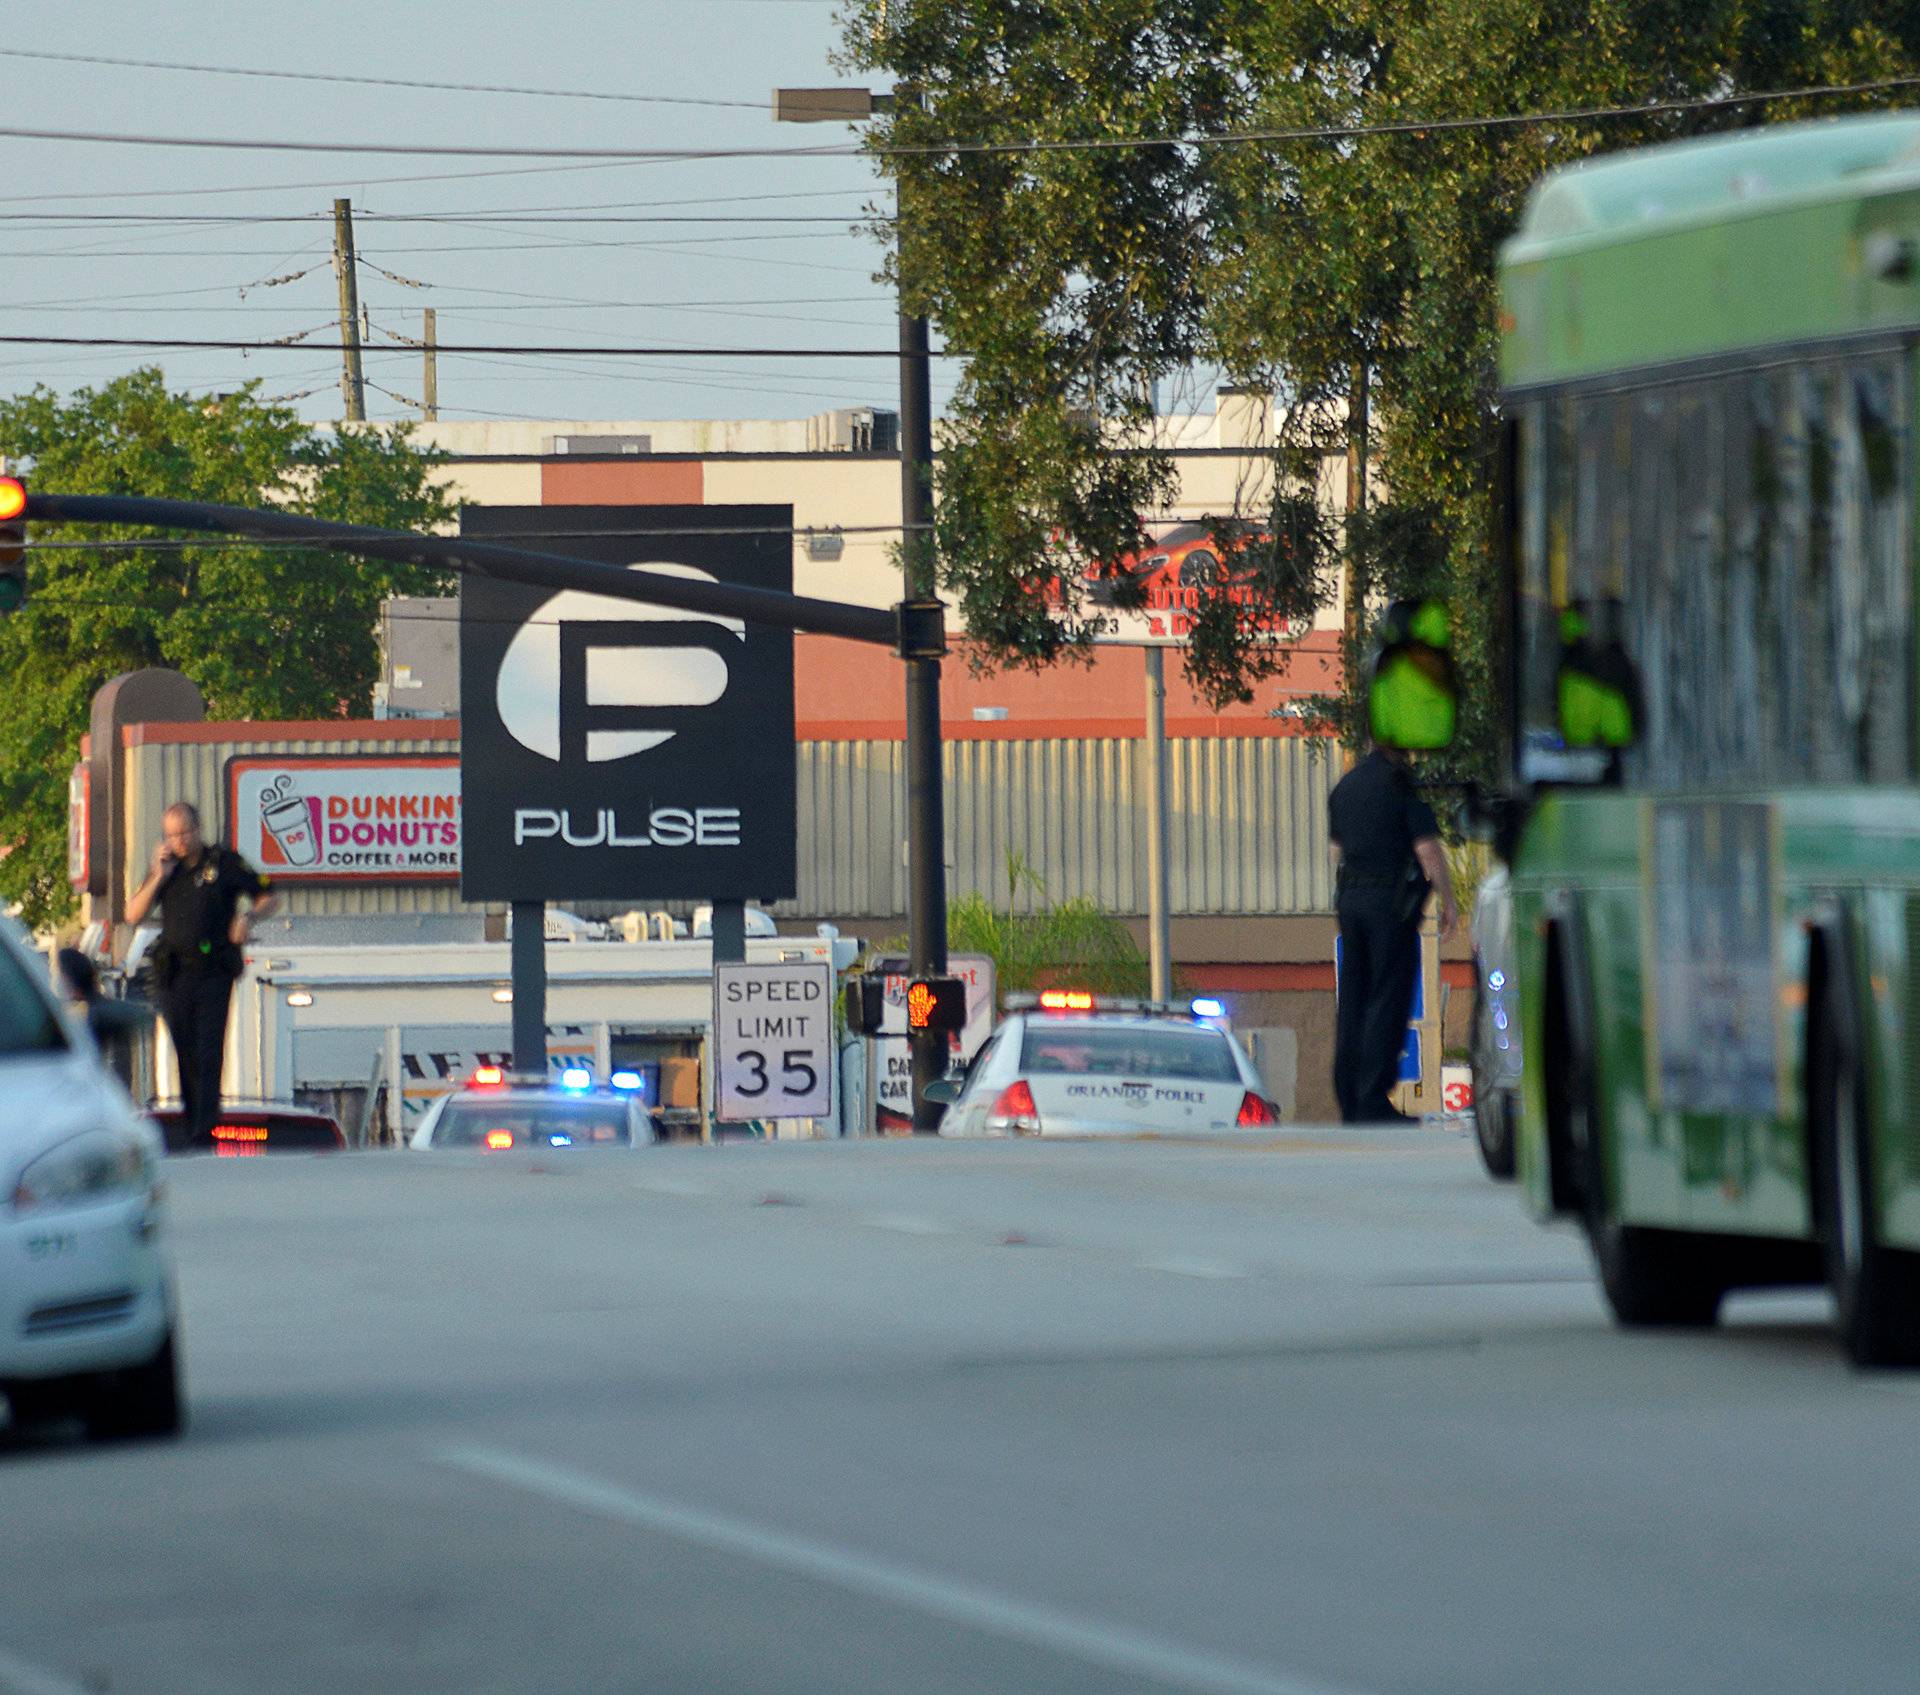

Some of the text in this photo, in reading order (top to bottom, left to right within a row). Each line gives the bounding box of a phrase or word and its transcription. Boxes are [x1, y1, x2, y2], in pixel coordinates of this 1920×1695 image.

[328, 823, 458, 846] DONUTS
[514, 807, 741, 847] PULSE
[327, 852, 392, 866] COFFEE
[408, 852, 458, 865] MORE
[726, 980, 822, 1003] SPEED
[737, 1016, 811, 1039] LIMIT
[734, 1049, 818, 1098] 35
[1066, 1083, 1206, 1104] ORLANDO POLICE
